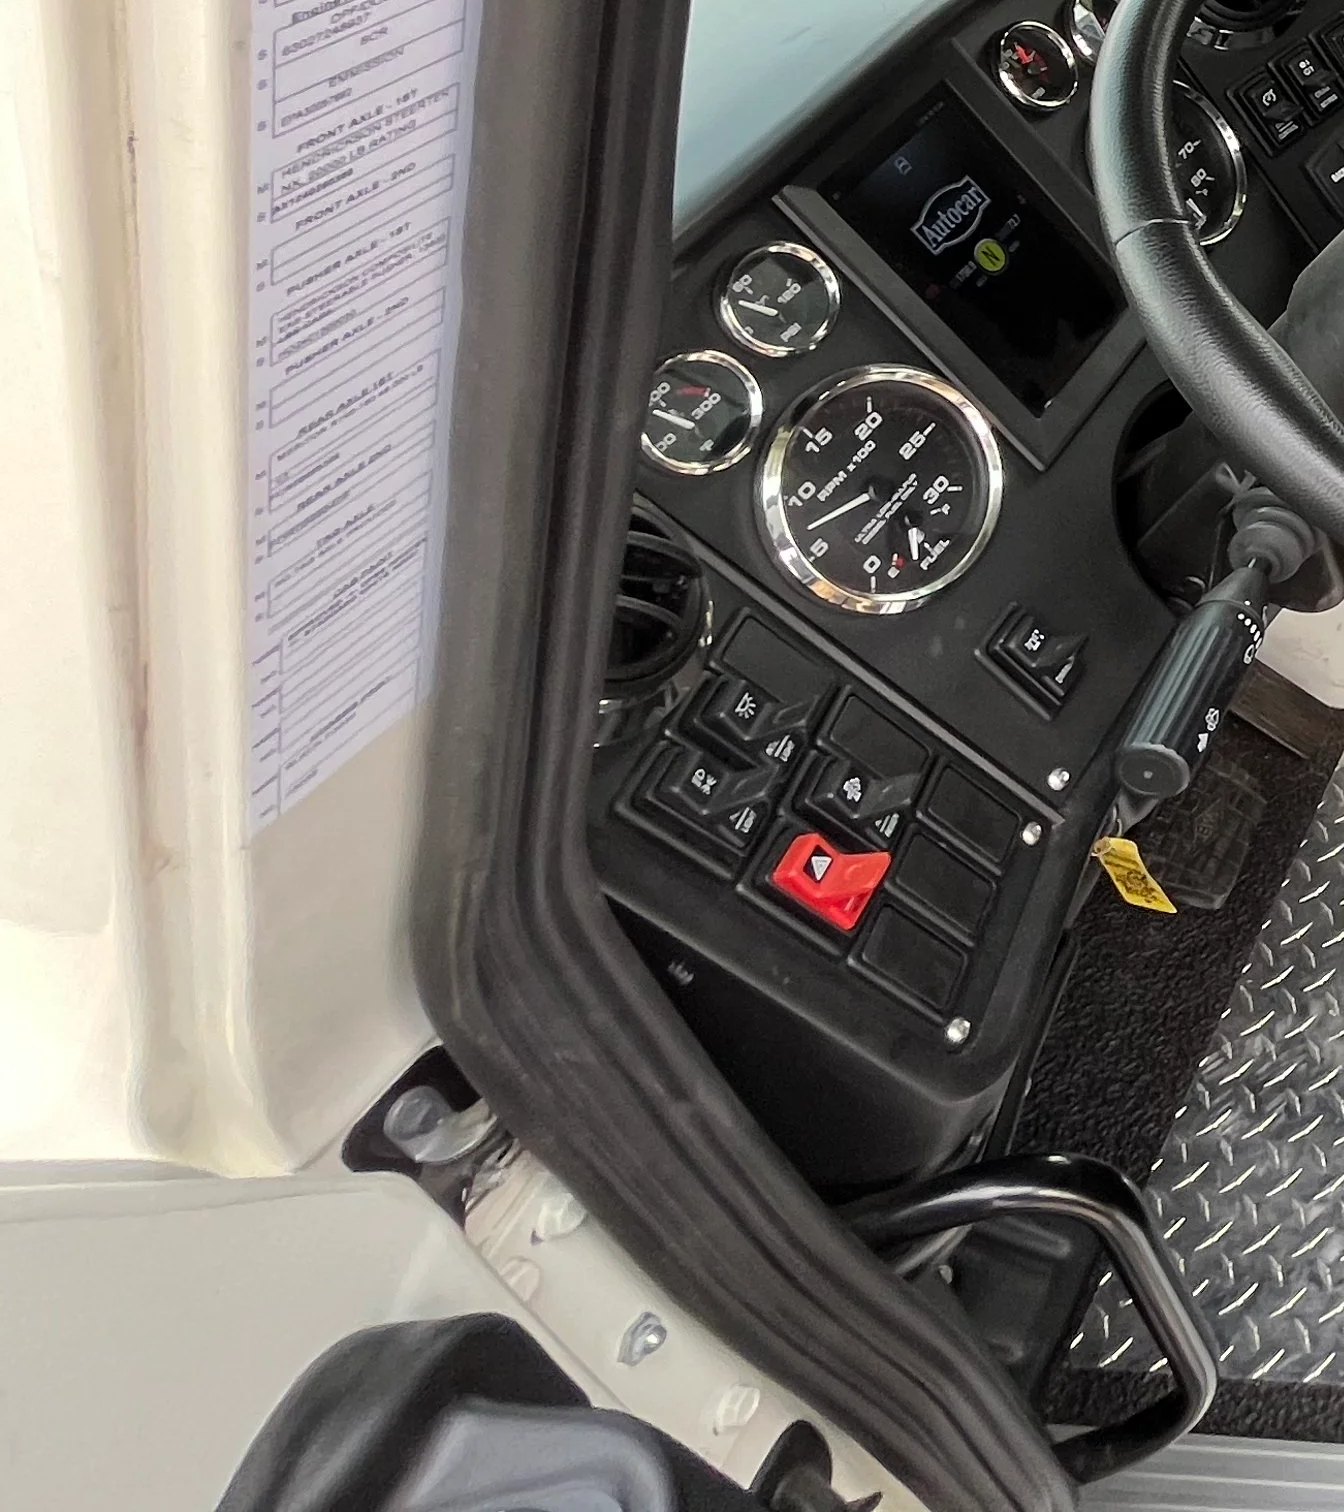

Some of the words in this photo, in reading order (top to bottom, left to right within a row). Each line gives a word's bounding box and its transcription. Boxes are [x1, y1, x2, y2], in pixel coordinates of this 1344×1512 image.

[297, 123, 344, 153] FRONT
[350, 104, 384, 129] AXLE
[1177, 140, 1196, 161] 70
[1189, 167, 1208, 188] 80
[295, 201, 342, 231] FRONT
[345, 182, 381, 205] AXLE
[921, 179, 982, 248] Autocar
[345, 239, 379, 265] AXLE
[979, 244, 1002, 268] N
[801, 425, 835, 458] 15
[851, 409, 885, 442] 20
[895, 429, 929, 461] 25
[784, 478, 819, 512] 10
[816, 470, 848, 502] RPM
[918, 473, 953, 507] 30
[807, 535, 831, 559] 5
[920, 539, 950, 571] FUEL
[860, 552, 884, 576] 0
